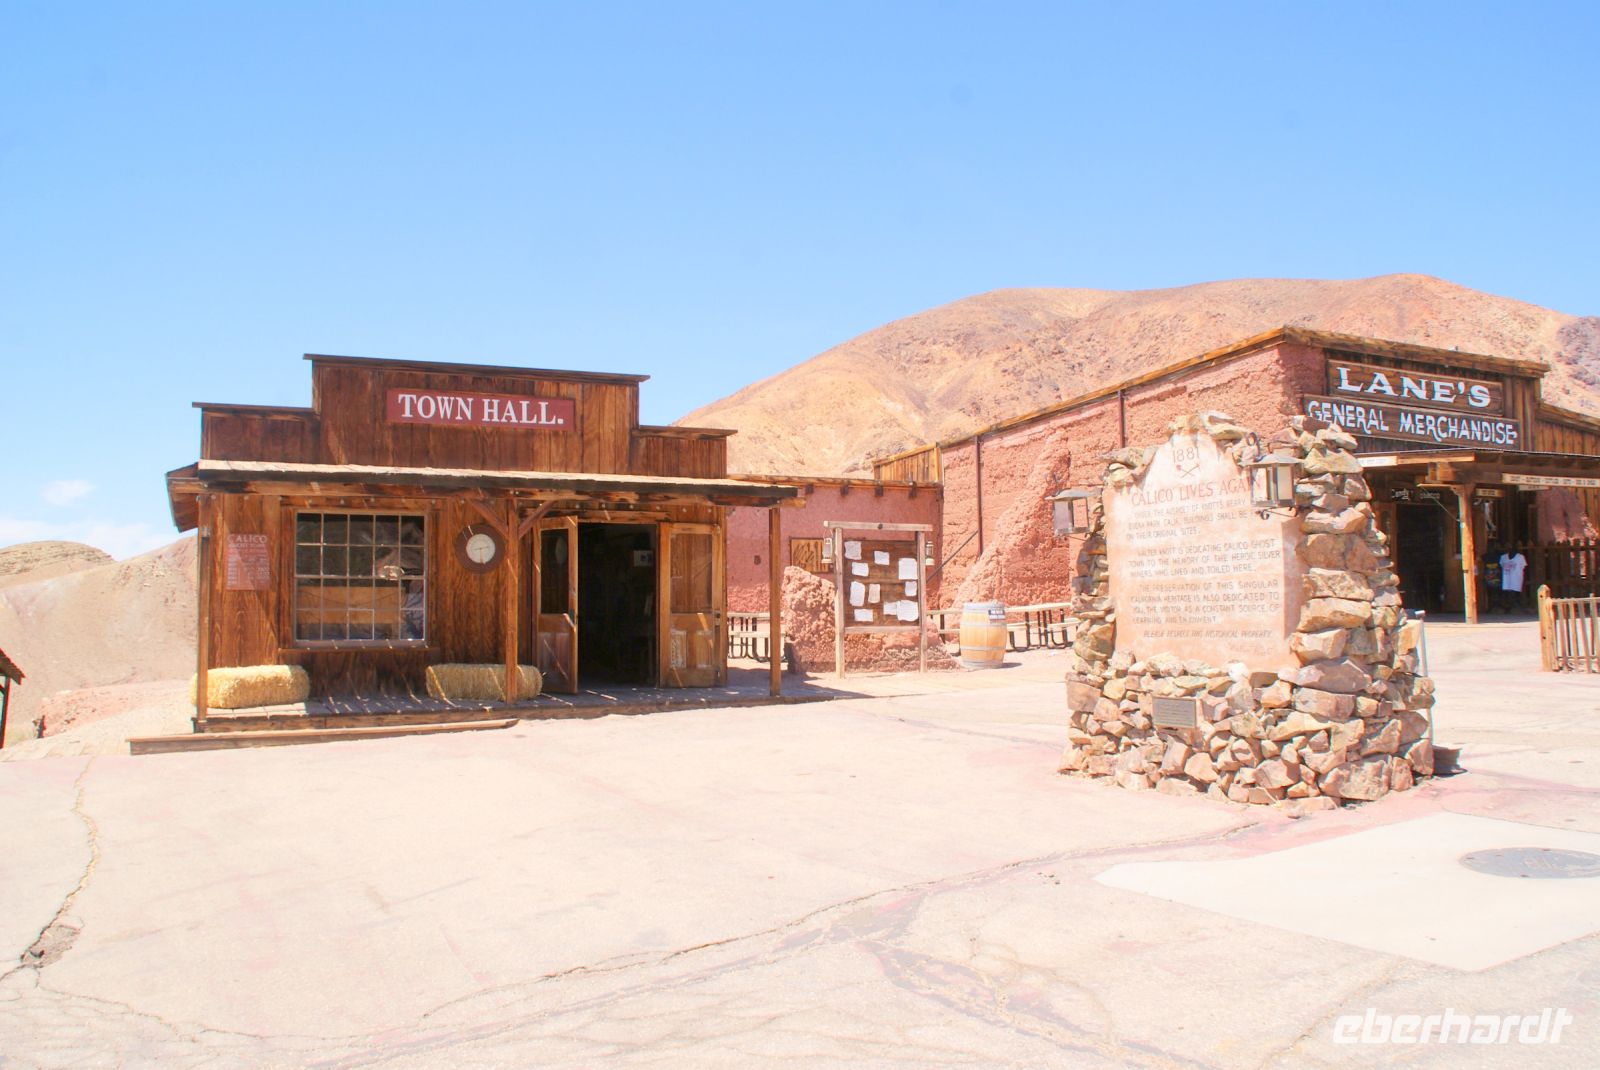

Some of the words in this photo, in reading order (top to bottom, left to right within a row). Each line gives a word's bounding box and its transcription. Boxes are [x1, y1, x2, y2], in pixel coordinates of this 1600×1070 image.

[1336, 367, 1491, 408] LANE'S
[398, 393, 474, 421] TOWN
[481, 398, 564, 425] HALL.
[1308, 400, 1389, 434] GENERAL
[1399, 412, 1518, 445] MERCHANDISE
[1172, 446, 1200, 464] 1881
[1131, 487, 1173, 507] CALICO
[1179, 481, 1214, 501] LIVES
[227, 534, 267, 544] CALICO
[1217, 581, 1234, 590] THIS
[1238, 579, 1279, 590] SINGULAR
[1223, 592, 1265, 602] DEDICATED
